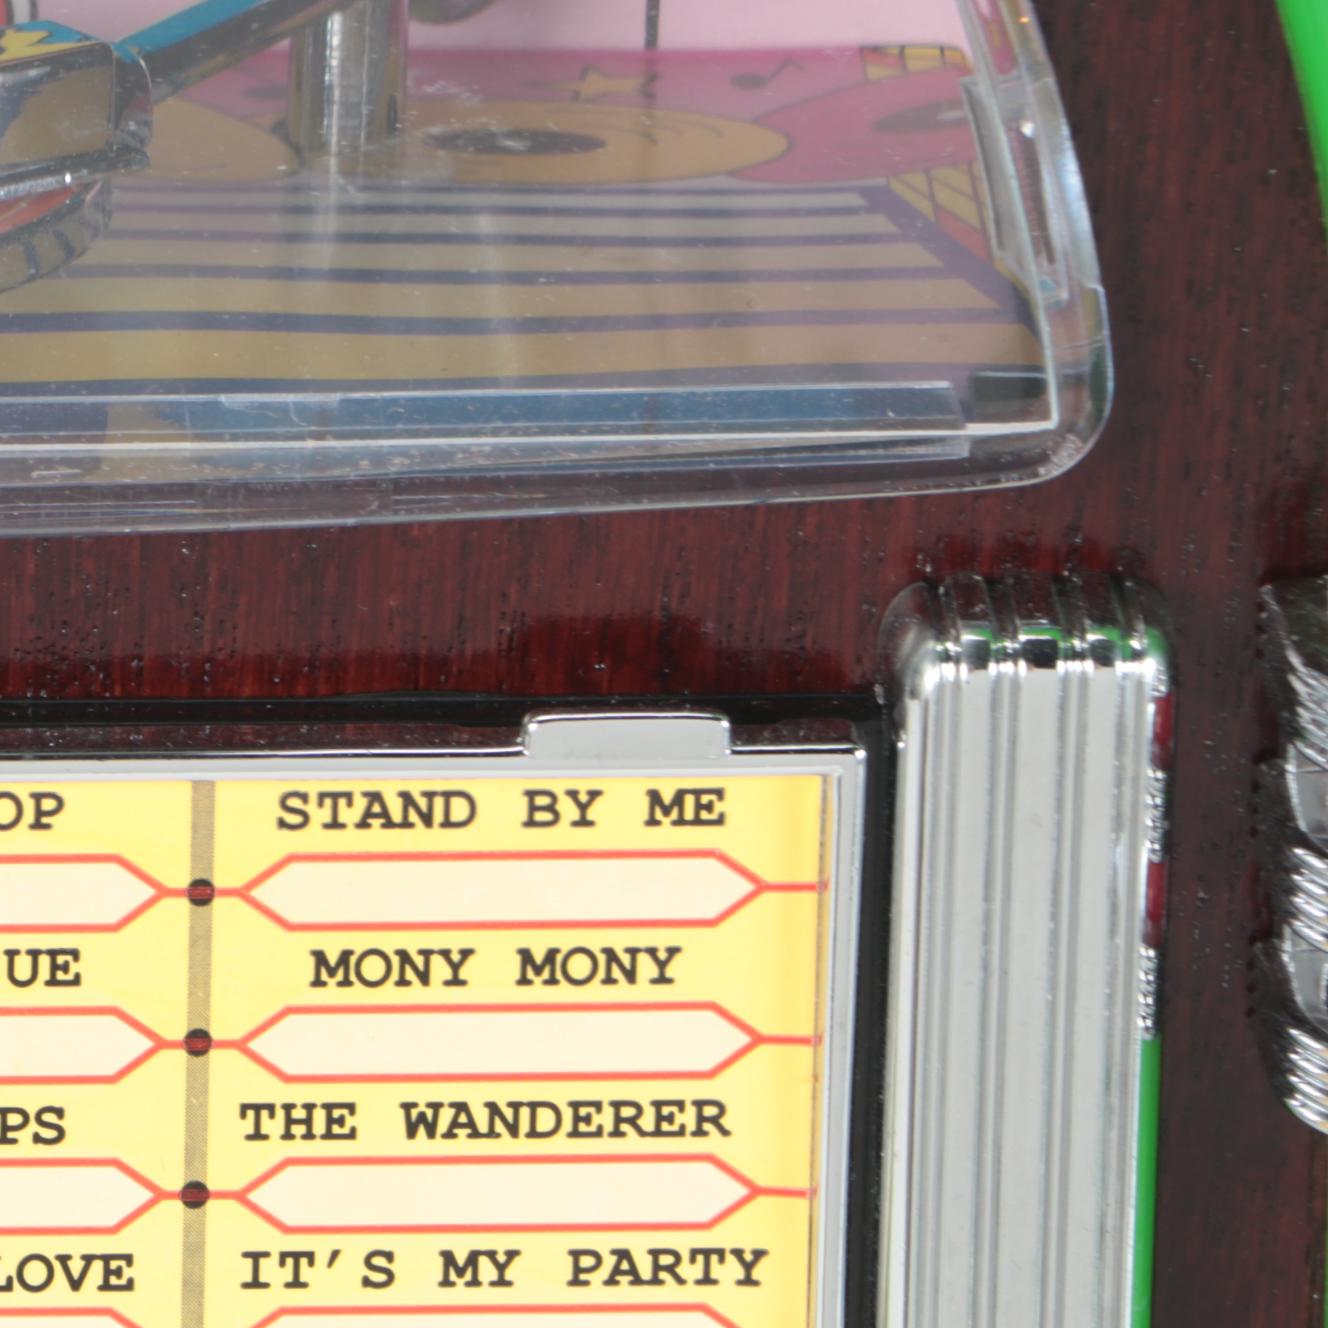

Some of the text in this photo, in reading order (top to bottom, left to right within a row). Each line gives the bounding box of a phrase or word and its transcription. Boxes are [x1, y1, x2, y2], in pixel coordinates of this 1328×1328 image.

[278, 788, 724, 830] STAND BY ME
[311, 947, 680, 988] MONY MONY
[240, 1099, 730, 1141] THE WANDERER
[242, 1248, 766, 1289] IT'S MY PARTY
